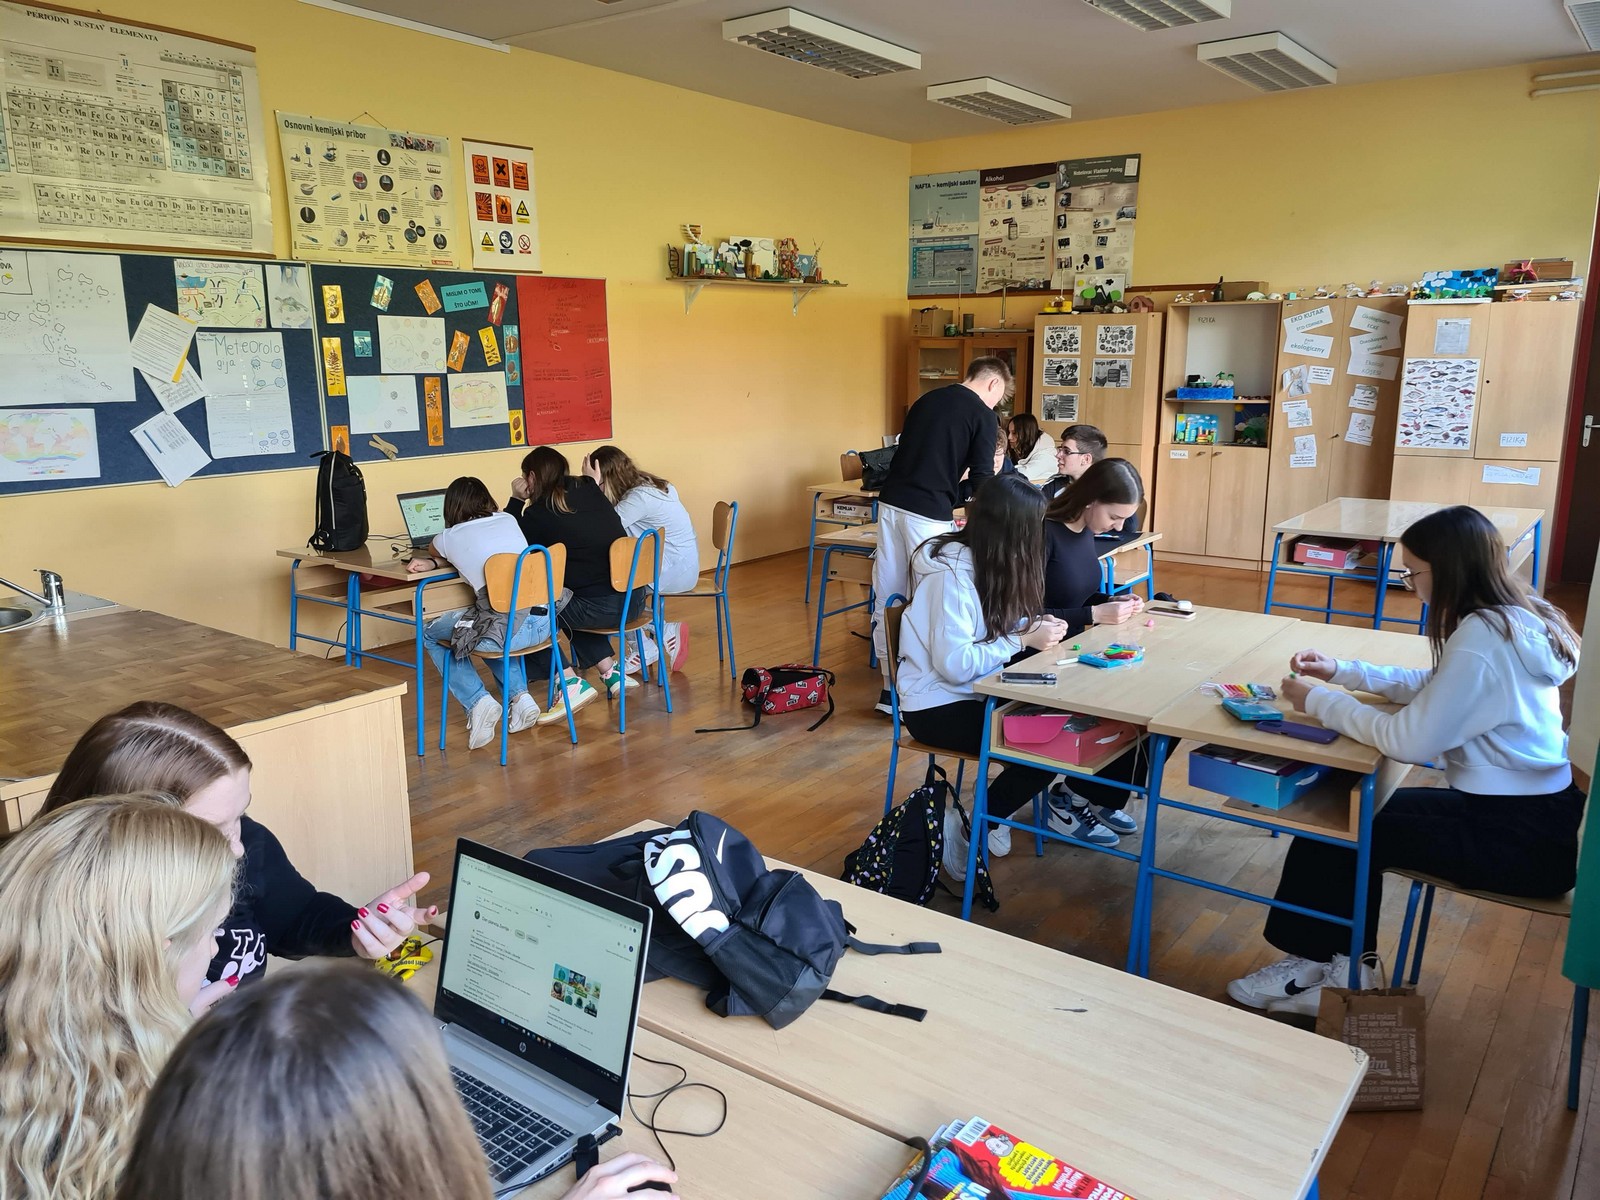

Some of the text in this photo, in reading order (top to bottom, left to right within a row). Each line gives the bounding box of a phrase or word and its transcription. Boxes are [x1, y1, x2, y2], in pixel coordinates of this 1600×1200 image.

[25, 10, 159, 42] PERIODNI SUSTAV ELEMENATA
[49, 65, 59, 74] Ti
[284, 119, 366, 139] Osnovni kemijski pribor
[1304, 308, 1325, 319] KUTAK
[1291, 343, 1325, 354] ekologiczny
[217, 358, 236, 374] gija
[1502, 436, 1526, 444] FIZIKA
[1022, 1156, 1038, 1176] MOZART
[1026, 1158, 1045, 1180] AMADEUS
[1031, 1160, 1053, 1184] WOLFGANG
